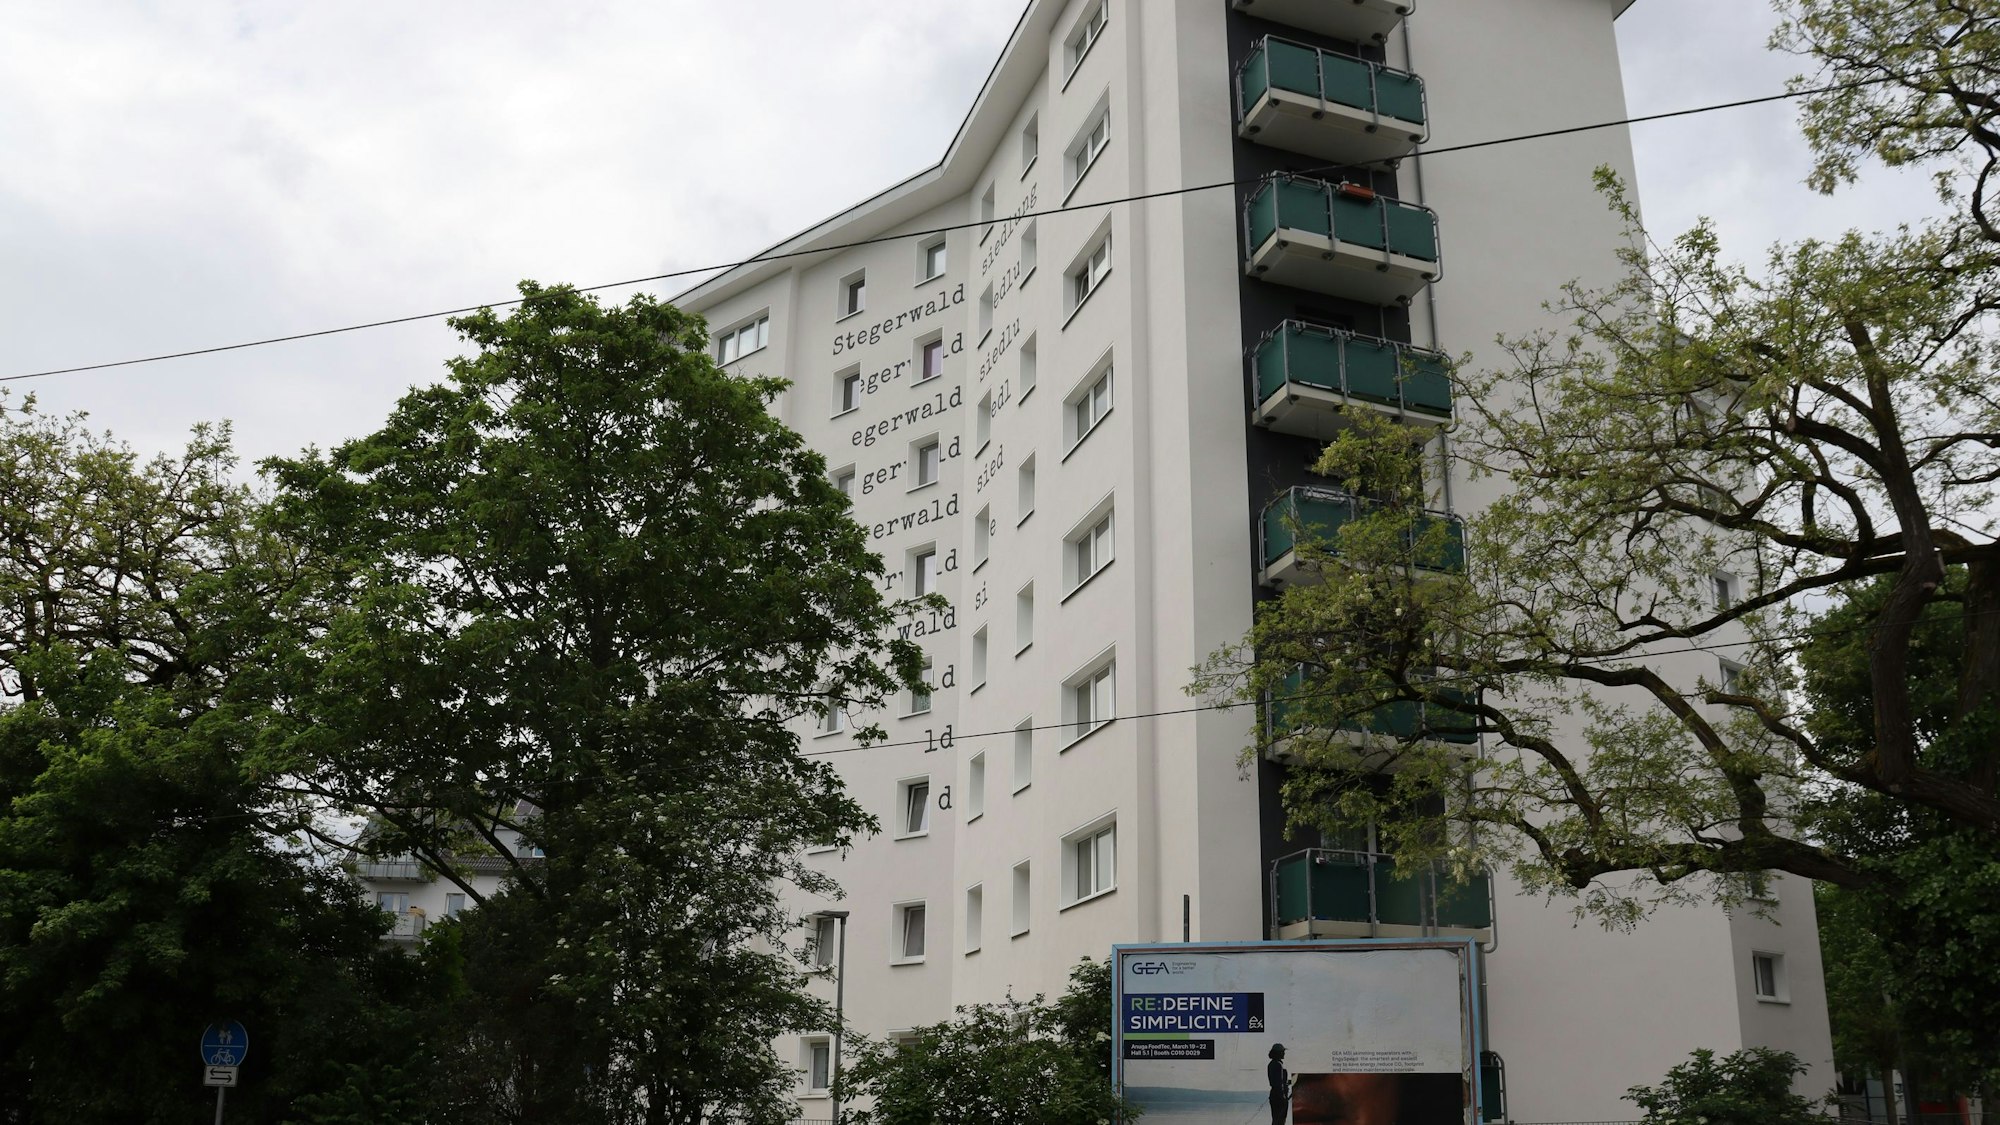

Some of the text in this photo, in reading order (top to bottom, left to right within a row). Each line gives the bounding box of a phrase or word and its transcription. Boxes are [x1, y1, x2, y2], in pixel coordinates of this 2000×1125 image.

[832, 182, 1037, 356] Stegerwald siedlung
[993, 260, 1021, 309] edlu
[851, 317, 1020, 447] egerwald siedlu
[862, 459, 907, 495] ger
[991, 378, 1012, 418] edl
[873, 444, 1004, 540] erwald sied
[897, 580, 989, 641] wald si
[924, 724, 954, 754] ld
[938, 785, 953, 811] d
[1132, 961, 1170, 975] GEA
[1130, 1015, 1239, 1029] SIMPLICITY.
[1131, 996, 1234, 1011] RE:DEFINE
